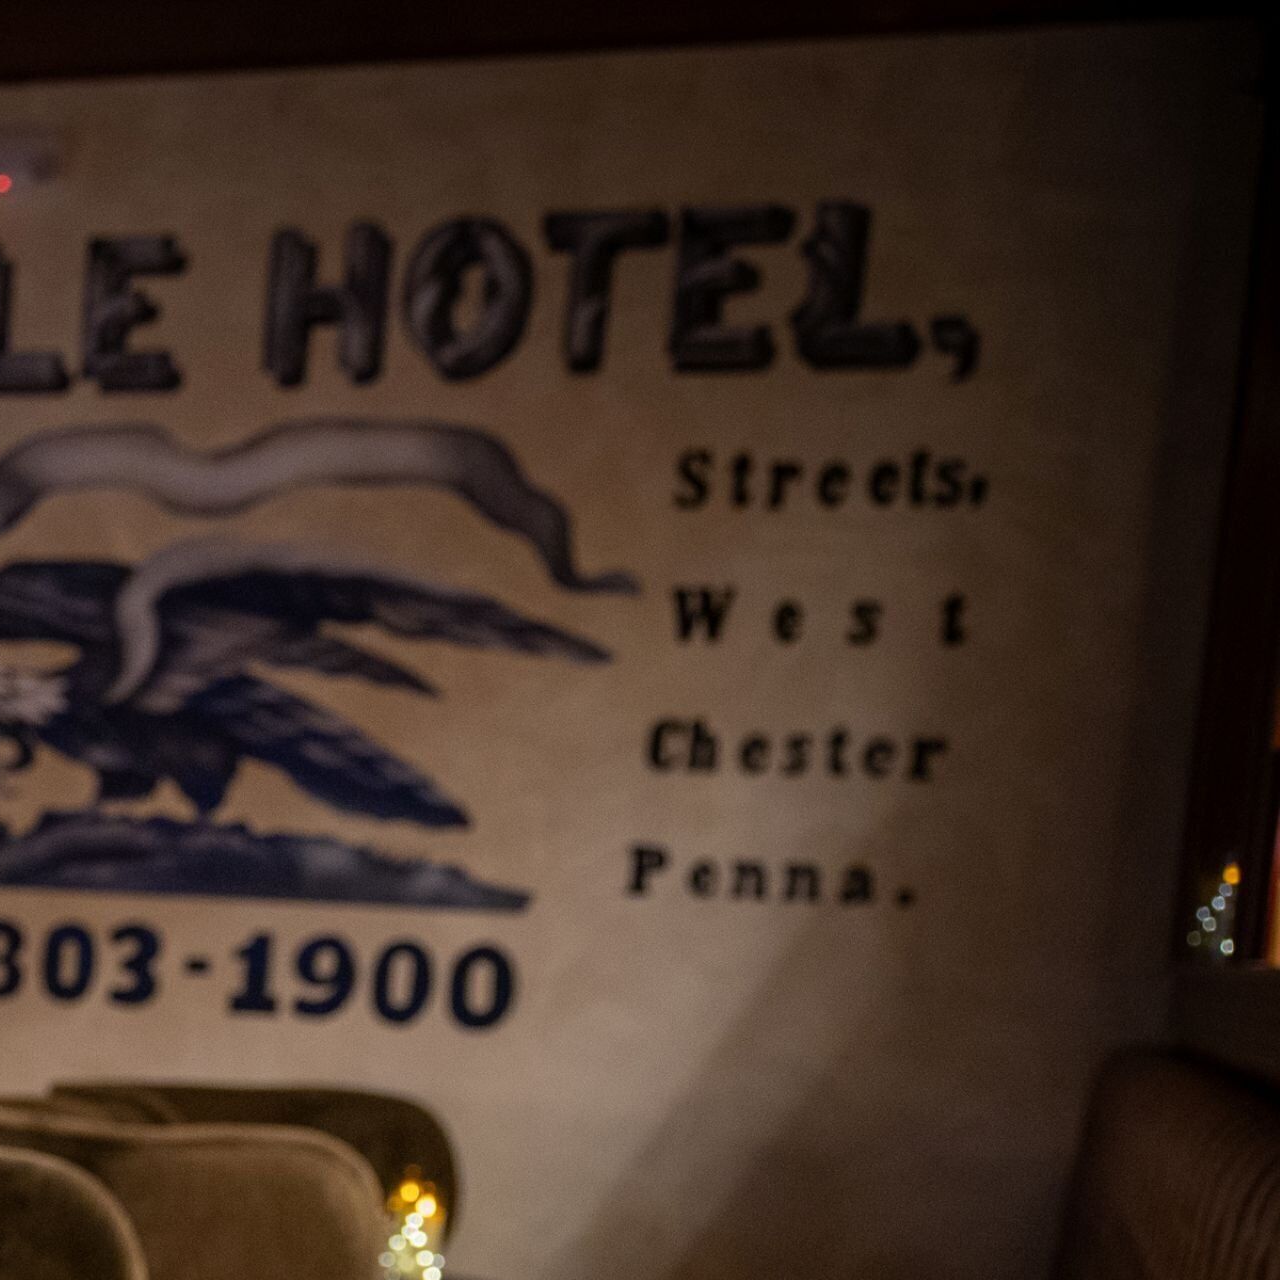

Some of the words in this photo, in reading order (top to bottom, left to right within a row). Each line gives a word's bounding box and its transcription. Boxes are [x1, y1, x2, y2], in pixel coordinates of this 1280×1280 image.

[262, 196, 981, 390] HOTEL,
[672, 583, 968, 646] West
[648, 718, 947, 783] Chester
[630, 842, 914, 906] Penna.
